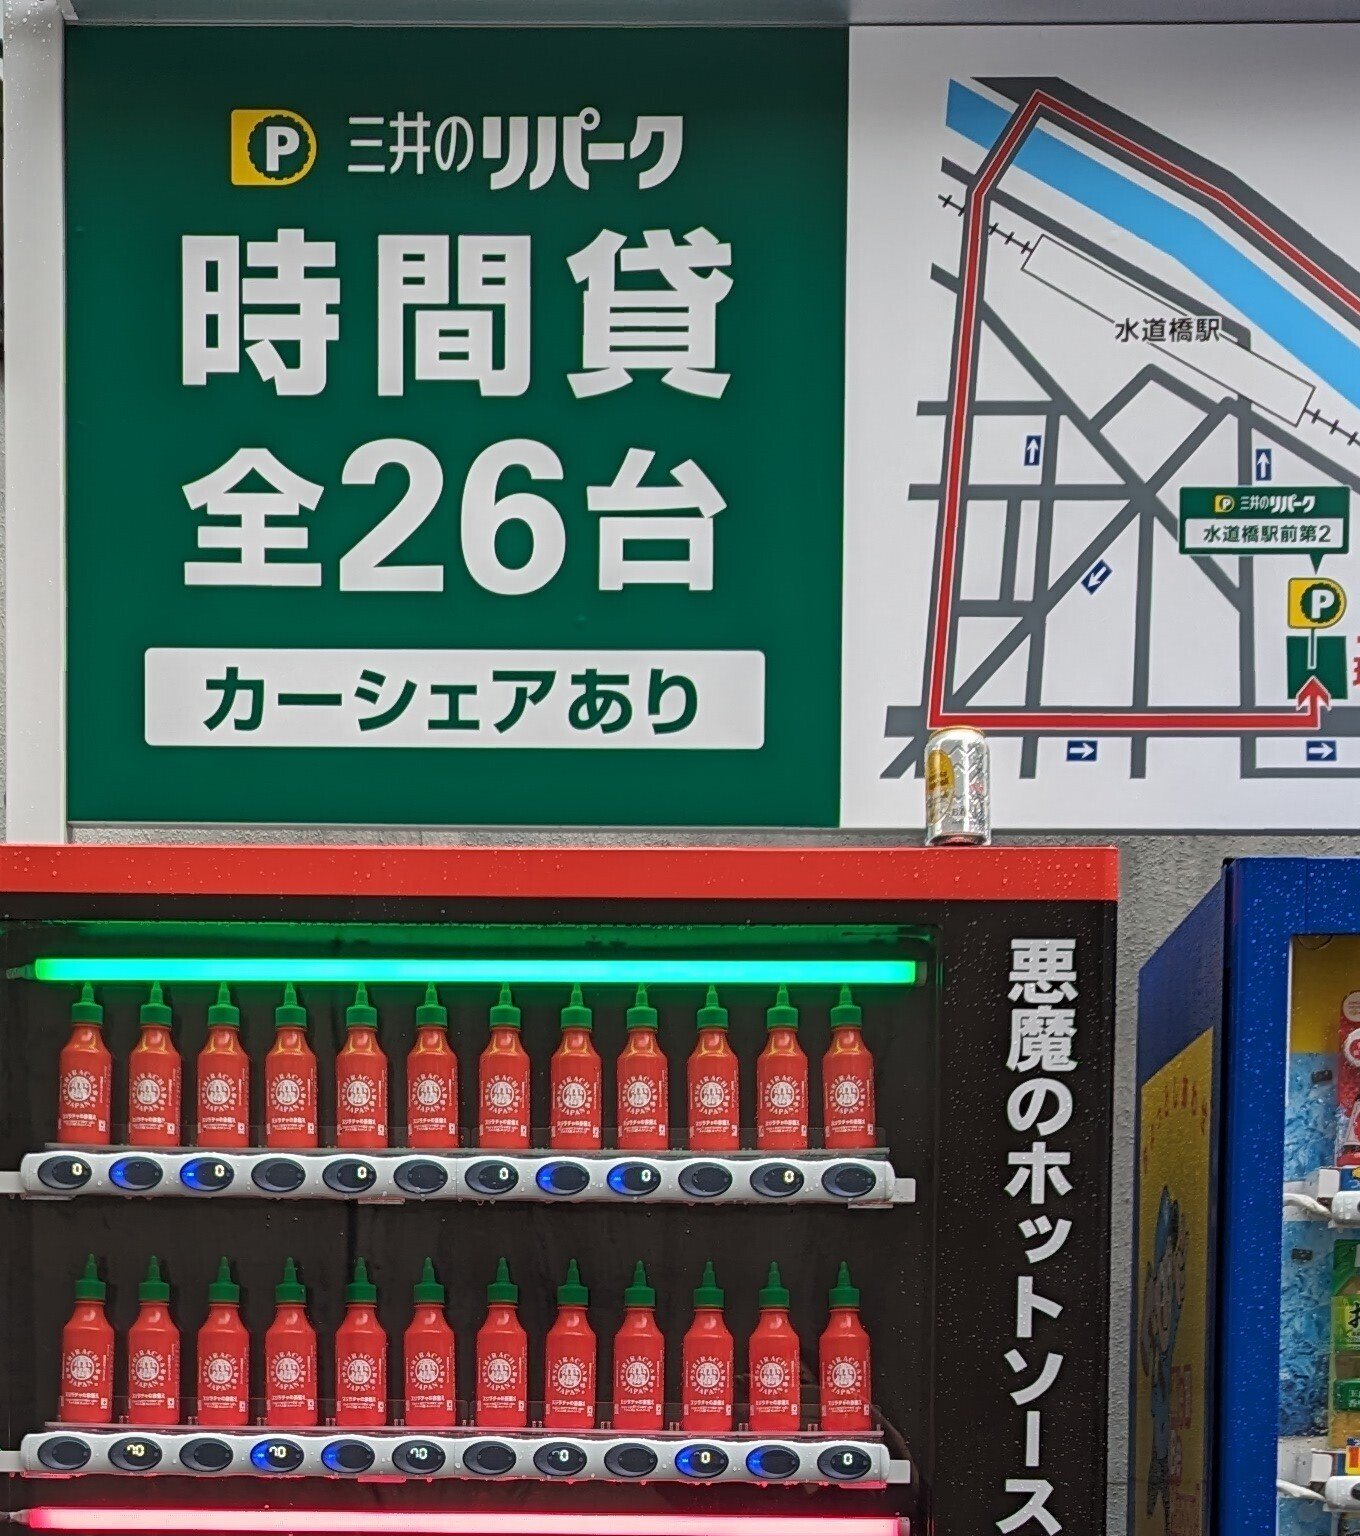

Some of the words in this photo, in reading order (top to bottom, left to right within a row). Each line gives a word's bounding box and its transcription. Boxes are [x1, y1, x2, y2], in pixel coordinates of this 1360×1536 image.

[347, 107, 683, 190] 三井のリパーク
[181, 227, 734, 399] 時間貸
[1115, 317, 1220, 344] 水道橋駅
[182, 439, 727, 596] 全26台
[1203, 524, 1331, 543] 水道橋駅前第2
[1240, 493, 1315, 513] 三井のリパーク
[203, 667, 699, 735] カーシェアあり
